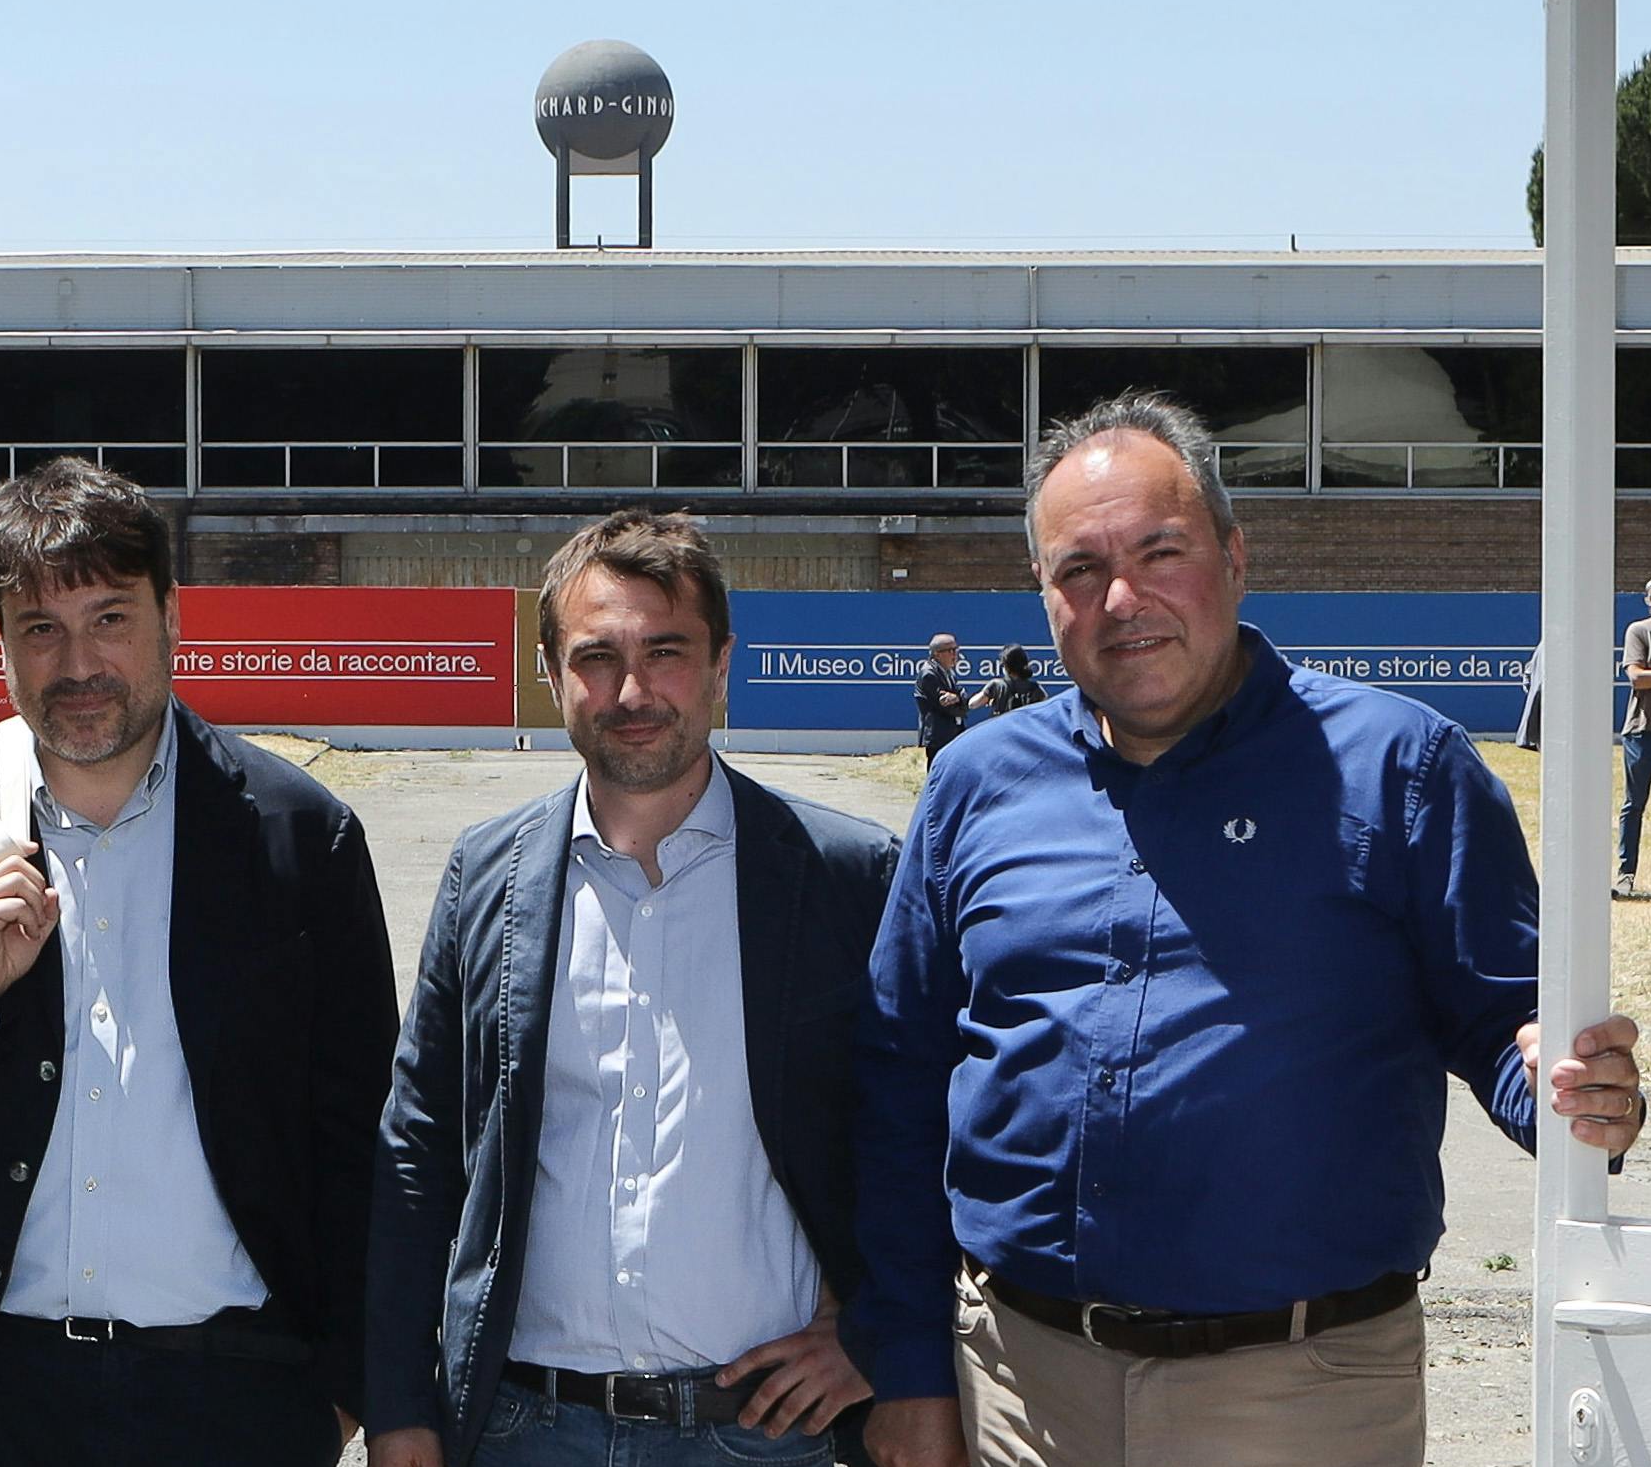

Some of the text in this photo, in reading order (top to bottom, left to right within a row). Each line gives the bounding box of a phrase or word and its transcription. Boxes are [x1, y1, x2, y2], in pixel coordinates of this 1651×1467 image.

[537, 95, 672, 118] ICHARD-GINO
[173, 650, 214, 671] nte
[222, 648, 292, 671] storie
[300, 648, 332, 672] da
[339, 650, 482, 672] raccontare.
[761, 652, 770, 676] Il
[779, 652, 864, 677] Museo
[955, 653, 971, 676] è
[979, 658, 1068, 676] anora
[1302, 656, 1370, 677] tante
[1378, 655, 1451, 677] storie
[1458, 655, 1492, 677] da
